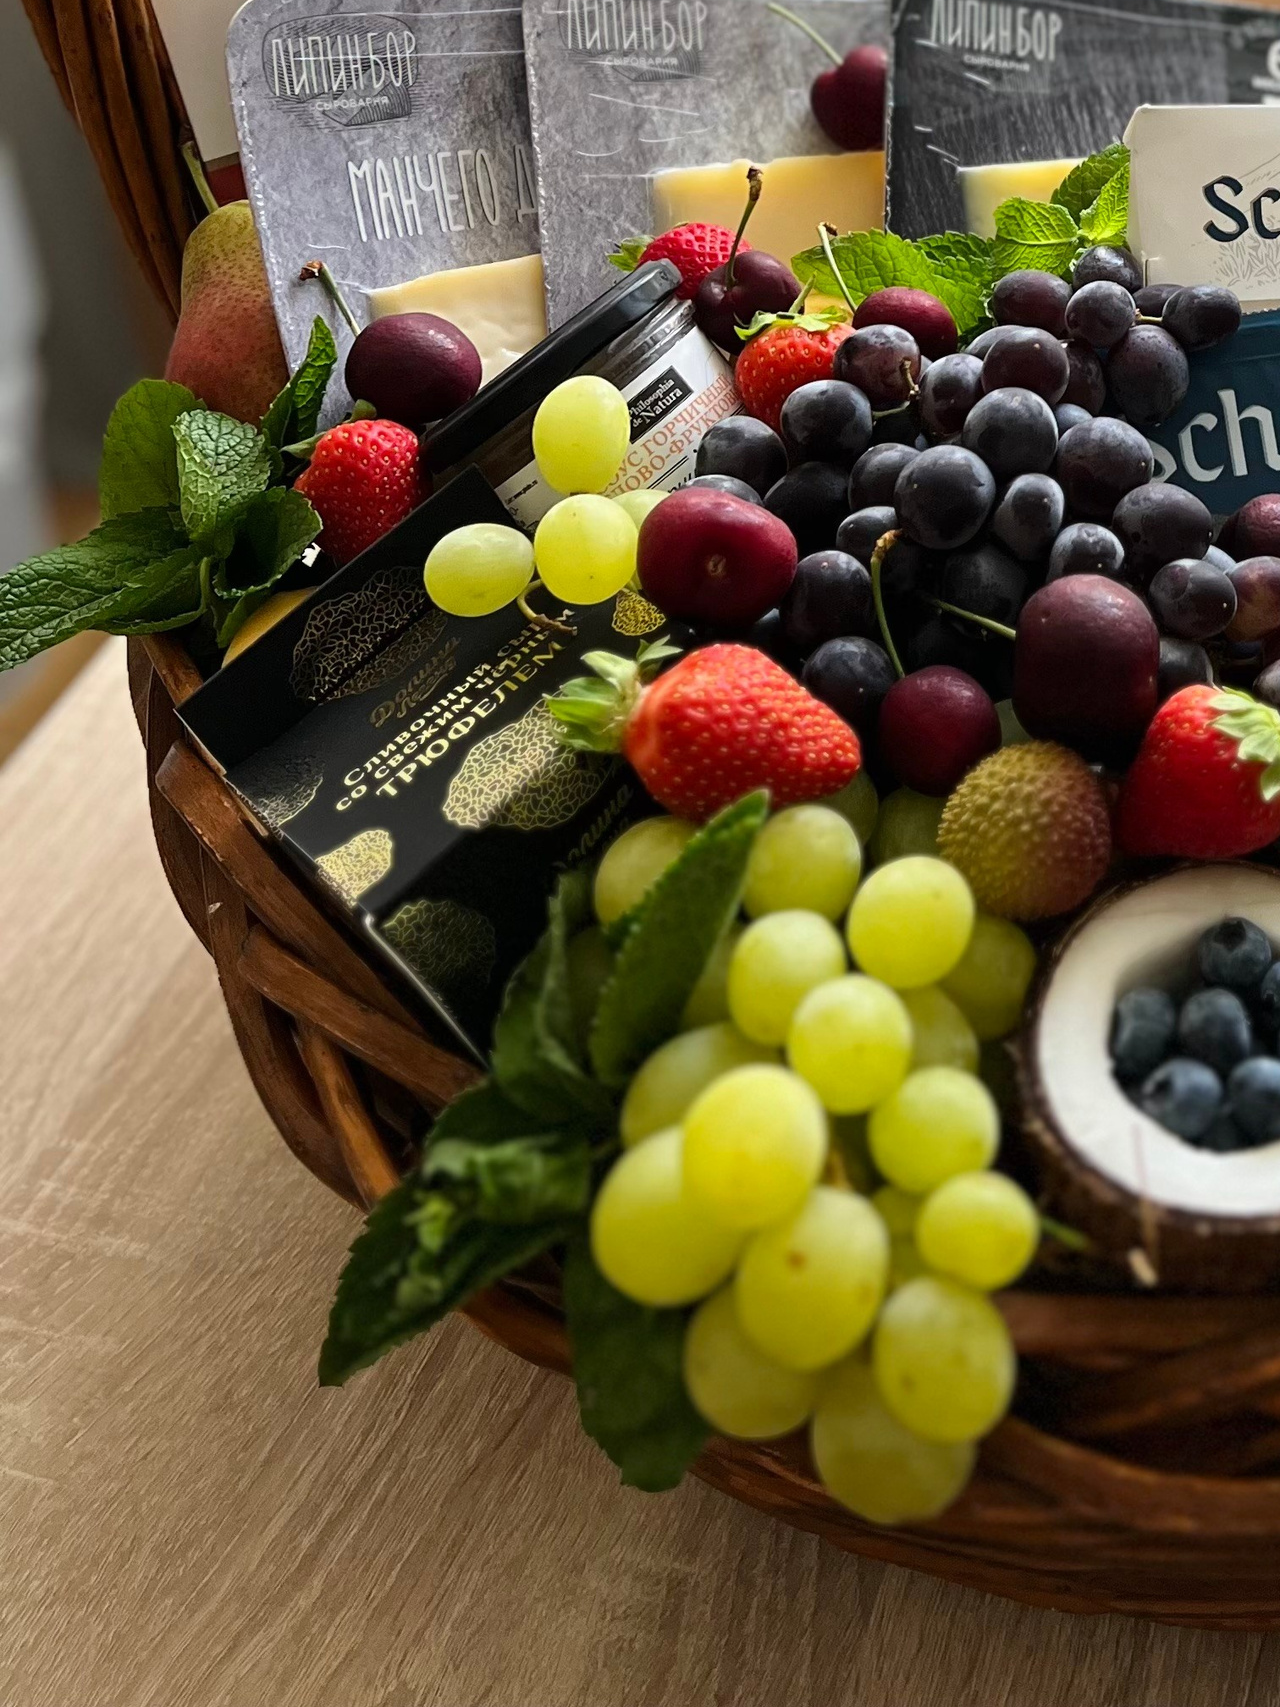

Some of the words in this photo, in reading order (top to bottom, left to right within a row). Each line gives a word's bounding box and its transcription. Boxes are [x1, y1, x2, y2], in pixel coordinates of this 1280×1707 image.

[347, 148, 500, 243] МАНЧЕГО
[641, 387, 683, 425] Natura
[336, 784, 368, 811] со
[374, 695, 473, 780] свежим
[343, 662, 492, 787] Сливочный
[375, 639, 567, 797] ТРЮФЕЛЕМ
